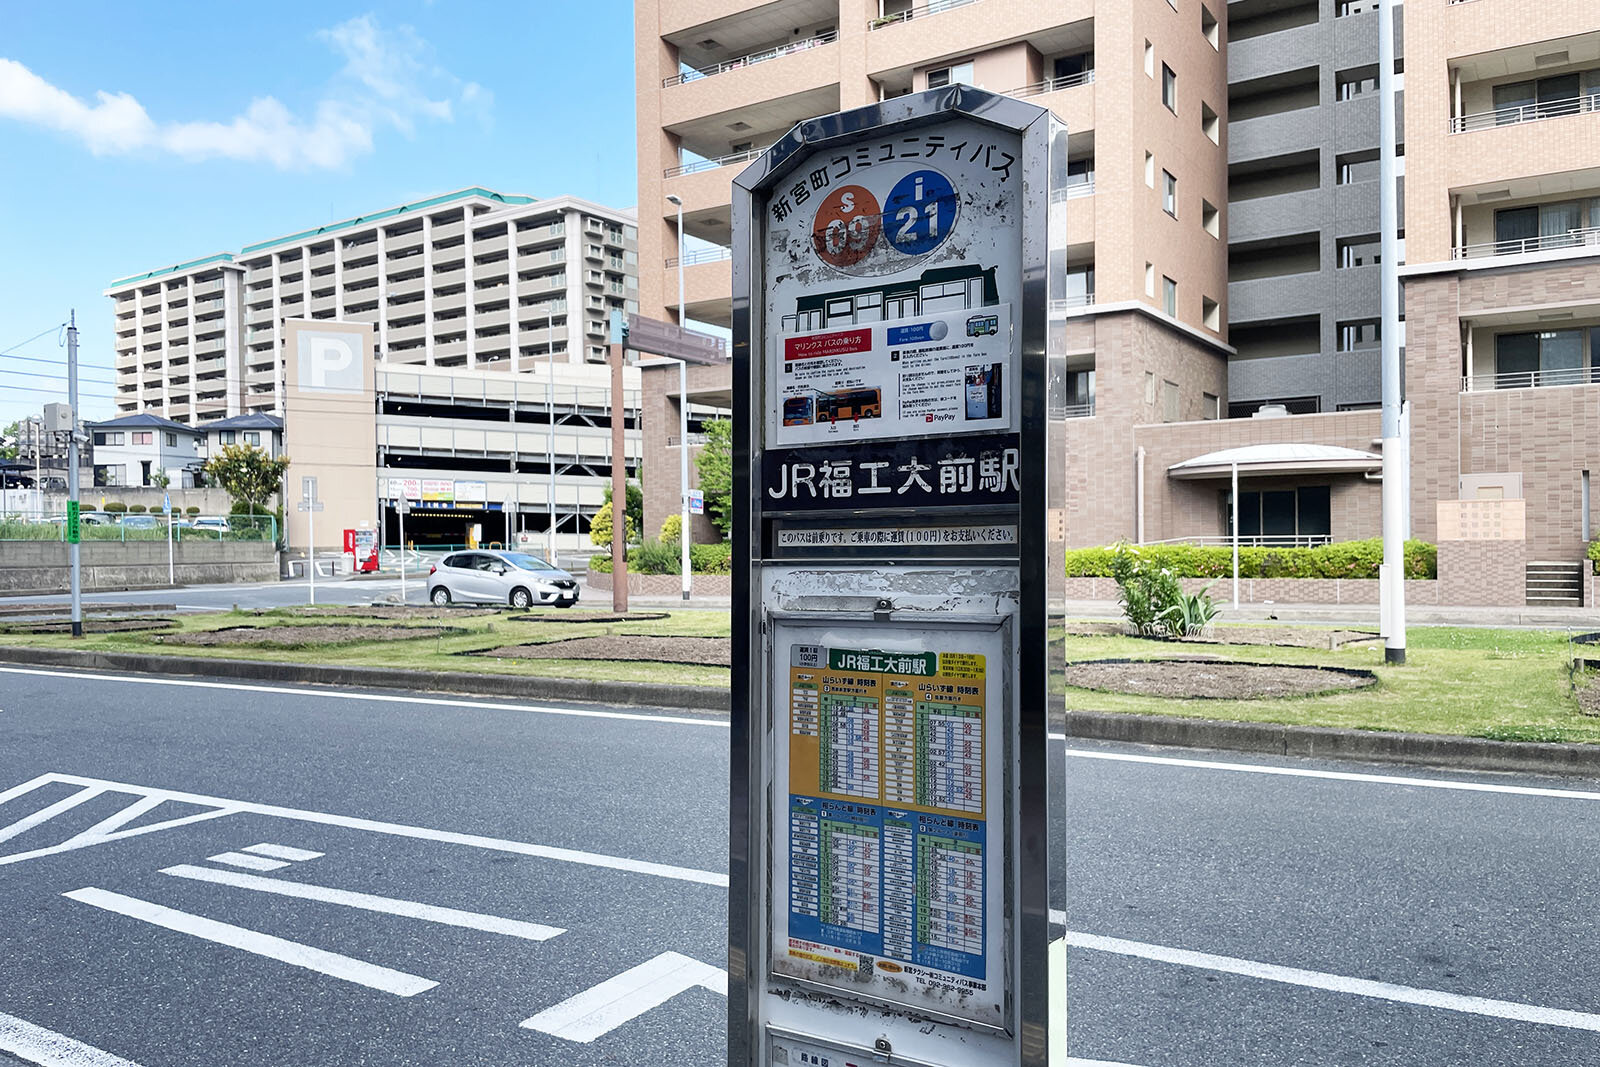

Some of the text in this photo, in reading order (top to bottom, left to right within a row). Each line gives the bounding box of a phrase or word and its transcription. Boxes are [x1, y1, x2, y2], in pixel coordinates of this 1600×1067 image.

[772, 136, 1015, 223] 新宮町コミュニティバス
[915, 177, 923, 200] i
[840, 192, 855, 213] S
[895, 203, 938, 243] 21
[824, 216, 870, 255] 09
[794, 336, 862, 351] マリンクス バスの乗り方
[311, 337, 352, 386] P
[934, 414, 956, 422] PayPay
[768, 448, 1021, 499] JR福工大前駅
[800, 654, 818, 662] 100円
[838, 654, 926, 675] JR福工大前駅
[957, 686, 979, 695] 時刻表
